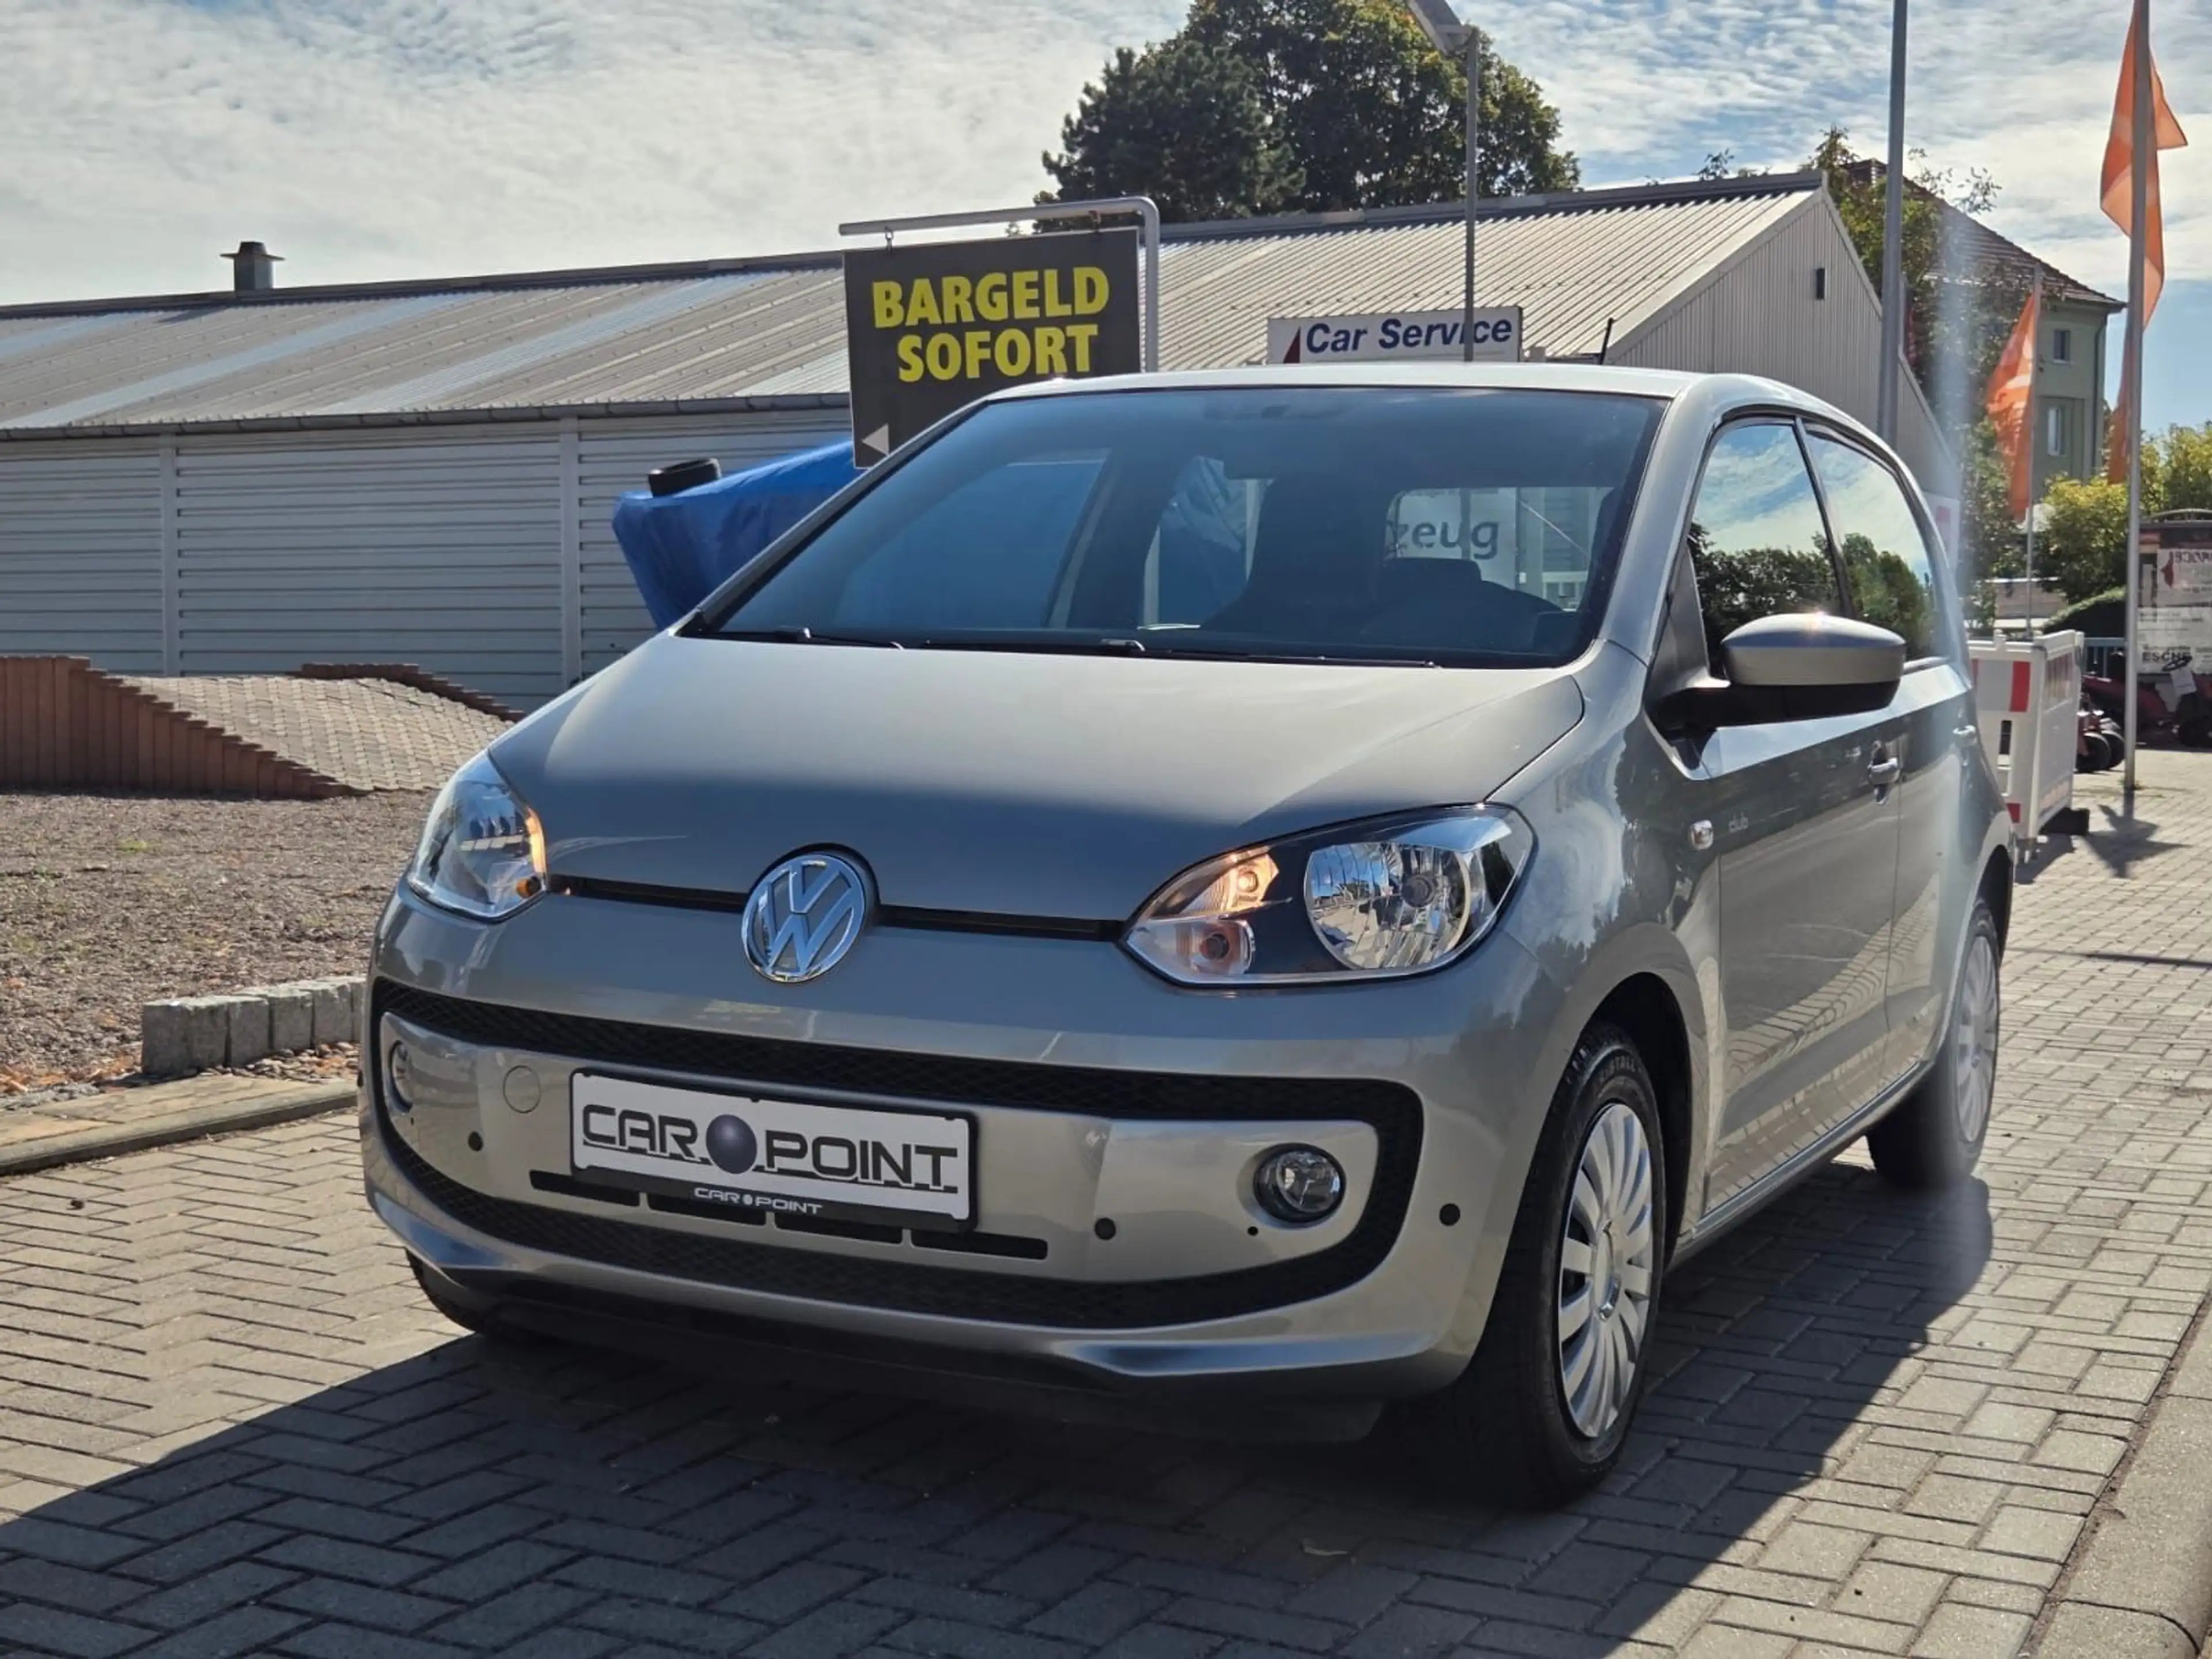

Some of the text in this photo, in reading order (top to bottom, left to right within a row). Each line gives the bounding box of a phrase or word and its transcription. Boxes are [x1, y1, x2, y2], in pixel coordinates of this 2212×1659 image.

[872, 267, 1109, 328] BARGELD
[897, 324, 1099, 382] SOFORT
[1306, 323, 1368, 354] Car
[749, 857, 859, 978] VW
[582, 1104, 958, 1188] CAR POINT
[694, 1187, 823, 1215] CAR POINT
